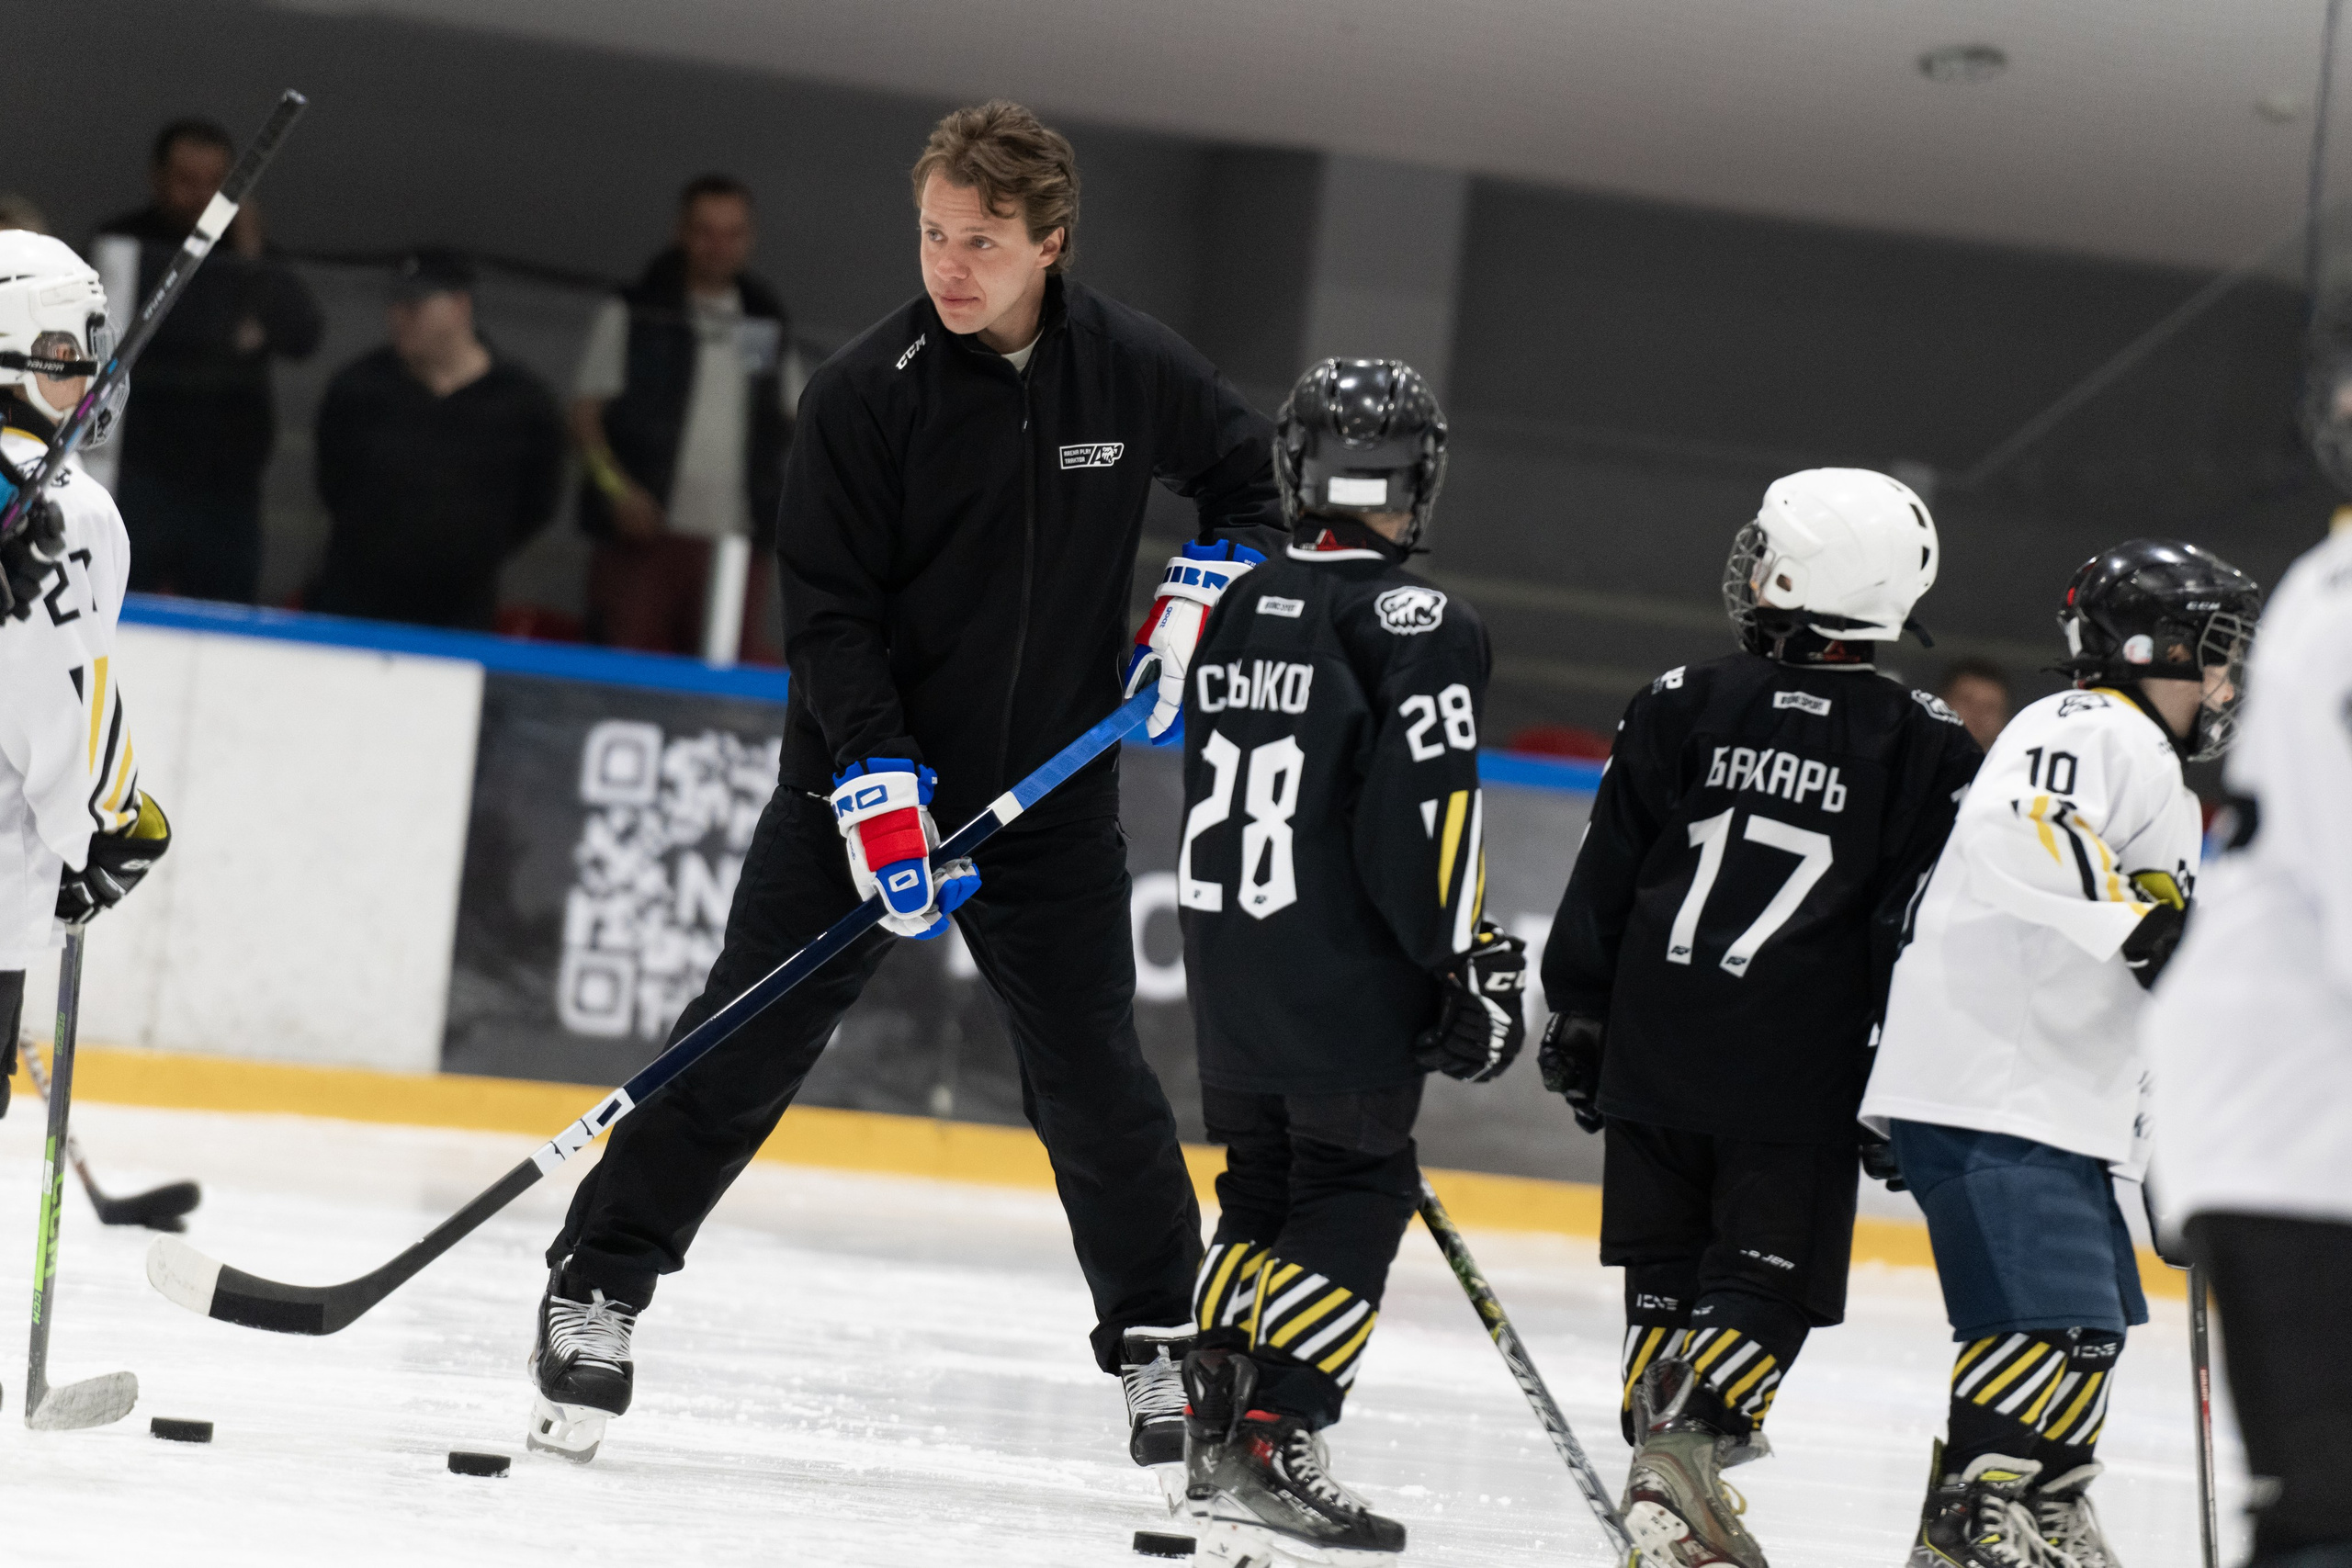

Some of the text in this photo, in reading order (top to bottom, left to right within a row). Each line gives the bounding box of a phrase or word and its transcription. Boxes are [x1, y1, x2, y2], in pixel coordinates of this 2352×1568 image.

[895, 333, 926, 370] CCM
[1197, 658, 1314, 715] СЫКО
[1398, 683, 1477, 762] 28
[1704, 746, 1848, 813] БАХАРЬ
[2025, 746, 2077, 795] 10
[1179, 728, 1306, 920] 28
[1666, 807, 1834, 979] 17
[32, 1289, 43, 1325] CCM
